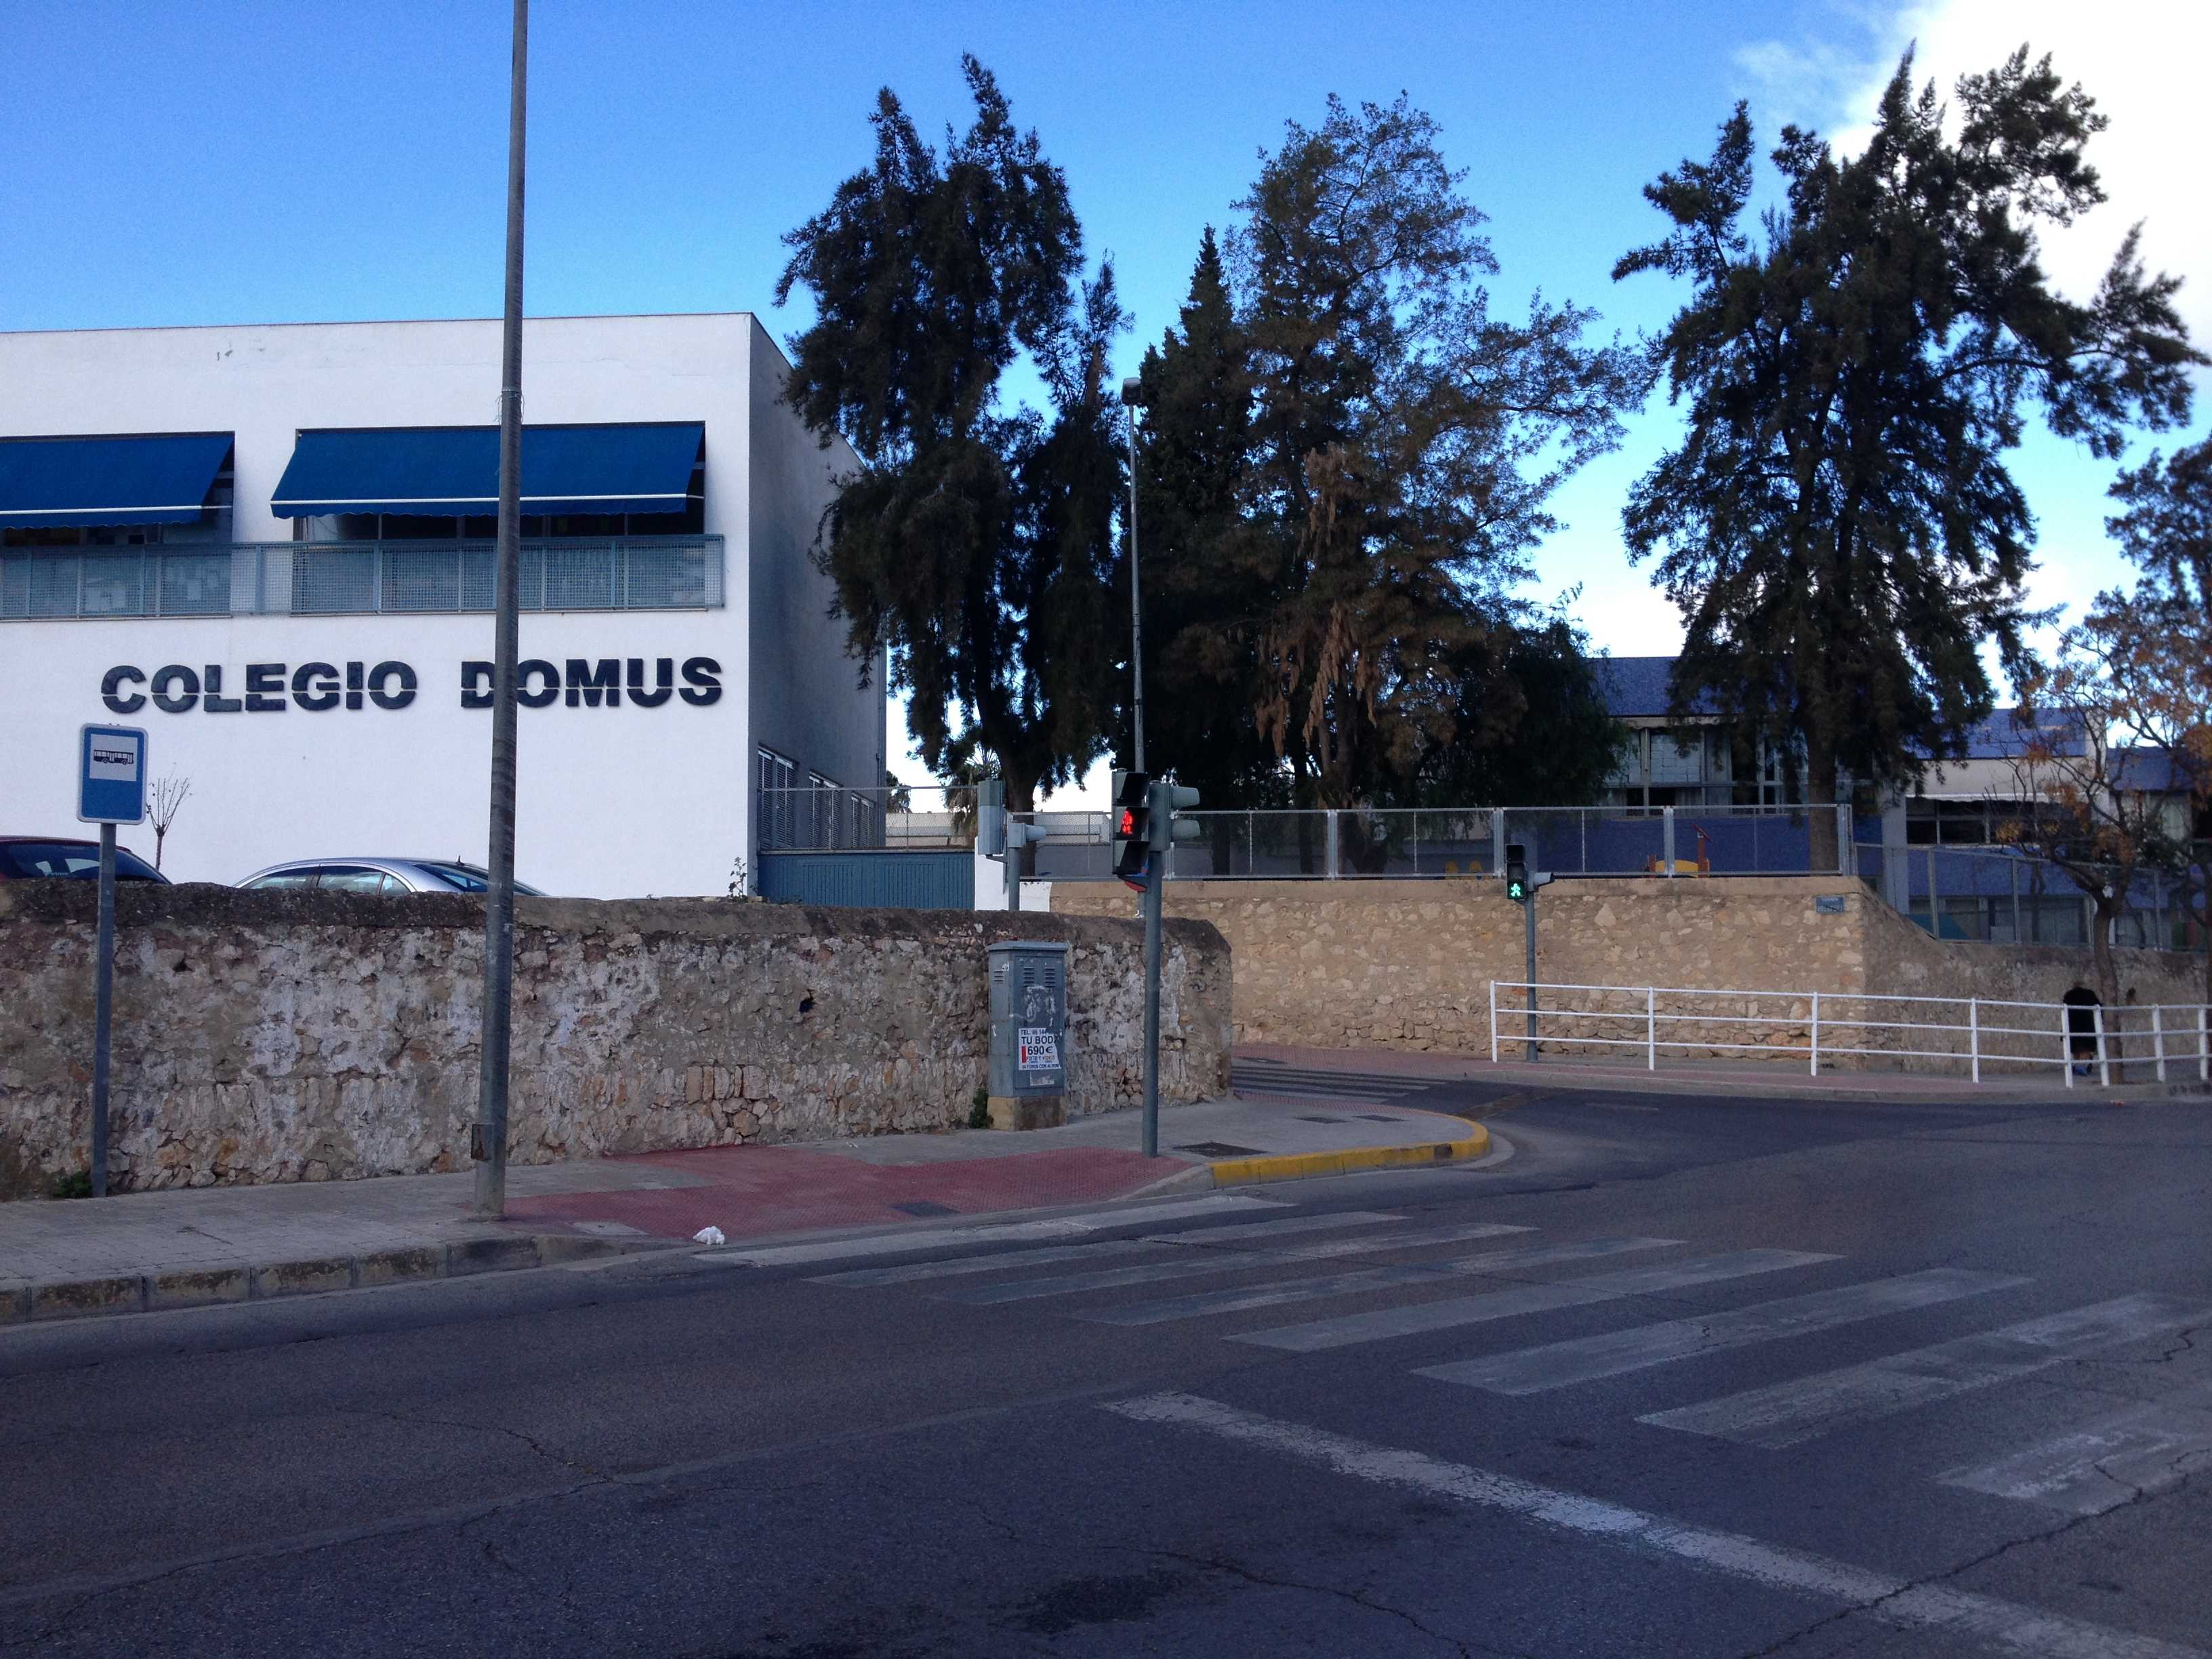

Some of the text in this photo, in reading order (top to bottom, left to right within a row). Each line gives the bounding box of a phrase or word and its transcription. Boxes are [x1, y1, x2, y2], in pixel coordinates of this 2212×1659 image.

[101, 657, 722, 714] COLEGIO DOMUS
[1021, 1036, 1032, 1044] TU
